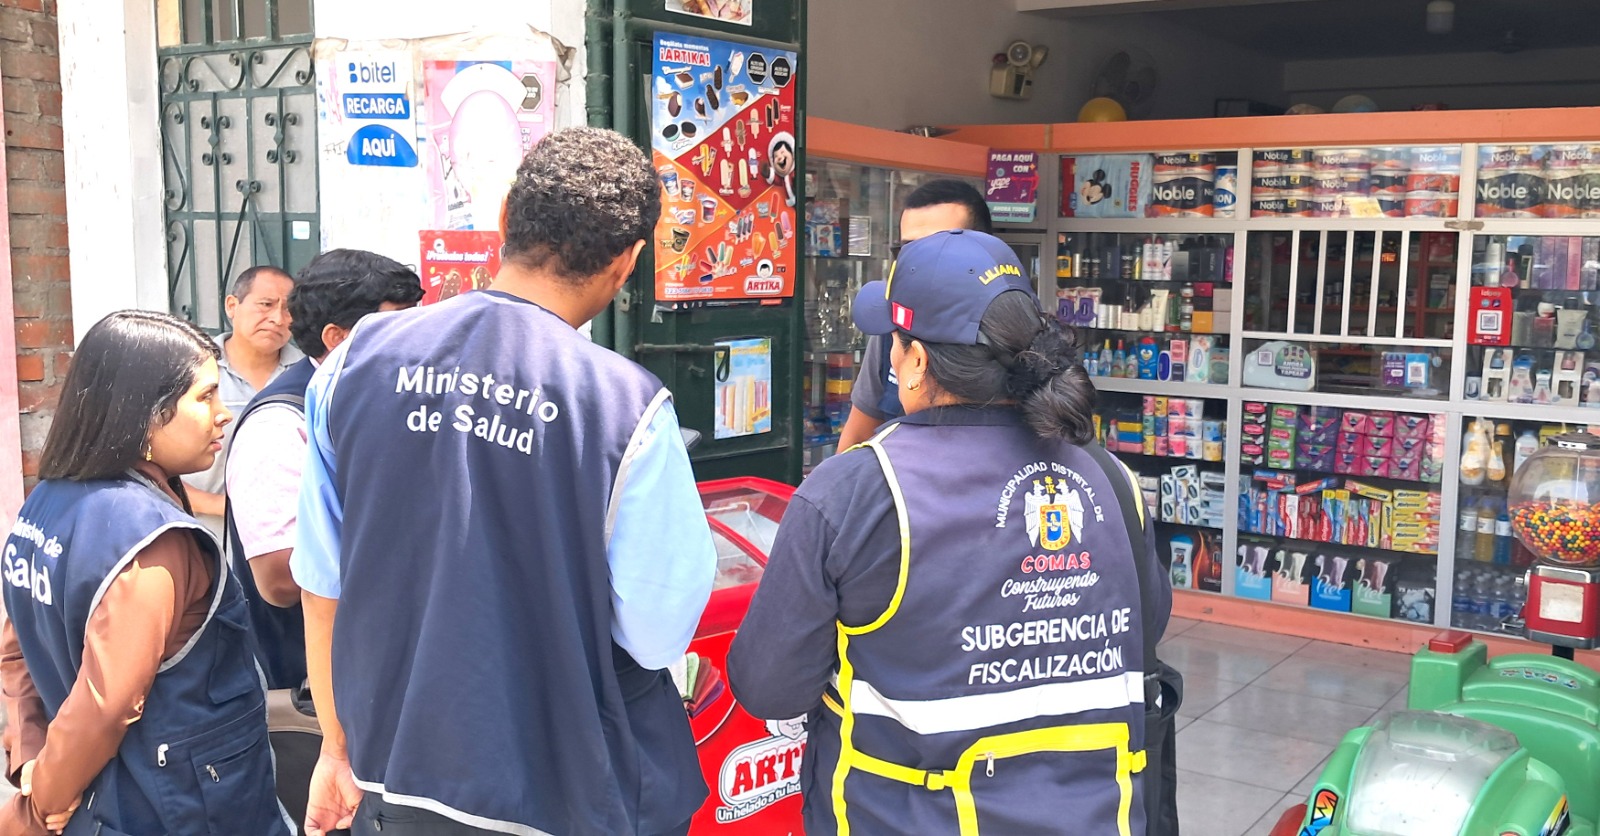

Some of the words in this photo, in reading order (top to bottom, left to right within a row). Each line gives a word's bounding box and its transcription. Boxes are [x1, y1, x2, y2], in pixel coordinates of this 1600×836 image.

[660, 48, 710, 66] ¡ARTIKA!
[360, 62, 396, 83] bitel
[346, 98, 406, 116] RECARGA
[362, 134, 396, 158] AQUÍ
[1562, 151, 1591, 160] Noble
[991, 154, 1012, 162] PAGA
[1013, 153, 1034, 162] AQUÍ
[1264, 152, 1288, 160] Noble
[1322, 156, 1349, 164] Noble
[1419, 154, 1447, 162] Noble
[1492, 153, 1520, 162] Noble
[1128, 162, 1140, 211] HUGGIES
[1261, 179, 1286, 187] Noble
[1322, 180, 1348, 188] Noble
[1476, 183, 1528, 200] Noble
[1548, 183, 1600, 200] Noble
[1153, 186, 1194, 201] Noble
[978, 264, 1021, 285] LILIANA
[747, 281, 780, 290] ARTIKA
[395, 366, 558, 422] Ministerio
[406, 405, 442, 431] de
[452, 404, 534, 454] Salud
[995, 462, 1048, 528] MUNICIPALIDAD
[1051, 462, 1096, 507] DISTRITAL
[1094, 505, 1104, 522] DE
[44, 535, 63, 558] de
[1020, 552, 1091, 574] COMAS
[1000, 570, 1100, 597] Construyendo
[1317, 574, 1345, 594] Piel
[1357, 578, 1386, 596] Piel
[1022, 592, 1081, 612] Futuros
[961, 613, 1107, 651] SUBGERENCIA
[1112, 608, 1131, 634] DE
[968, 639, 1123, 684] FISCALIZACIÓN
[719, 809, 732, 821] Un
[733, 796, 764, 817] helado
[766, 794, 774, 803] a
[774, 788, 786, 800] tu
[786, 782, 801, 795] lad
